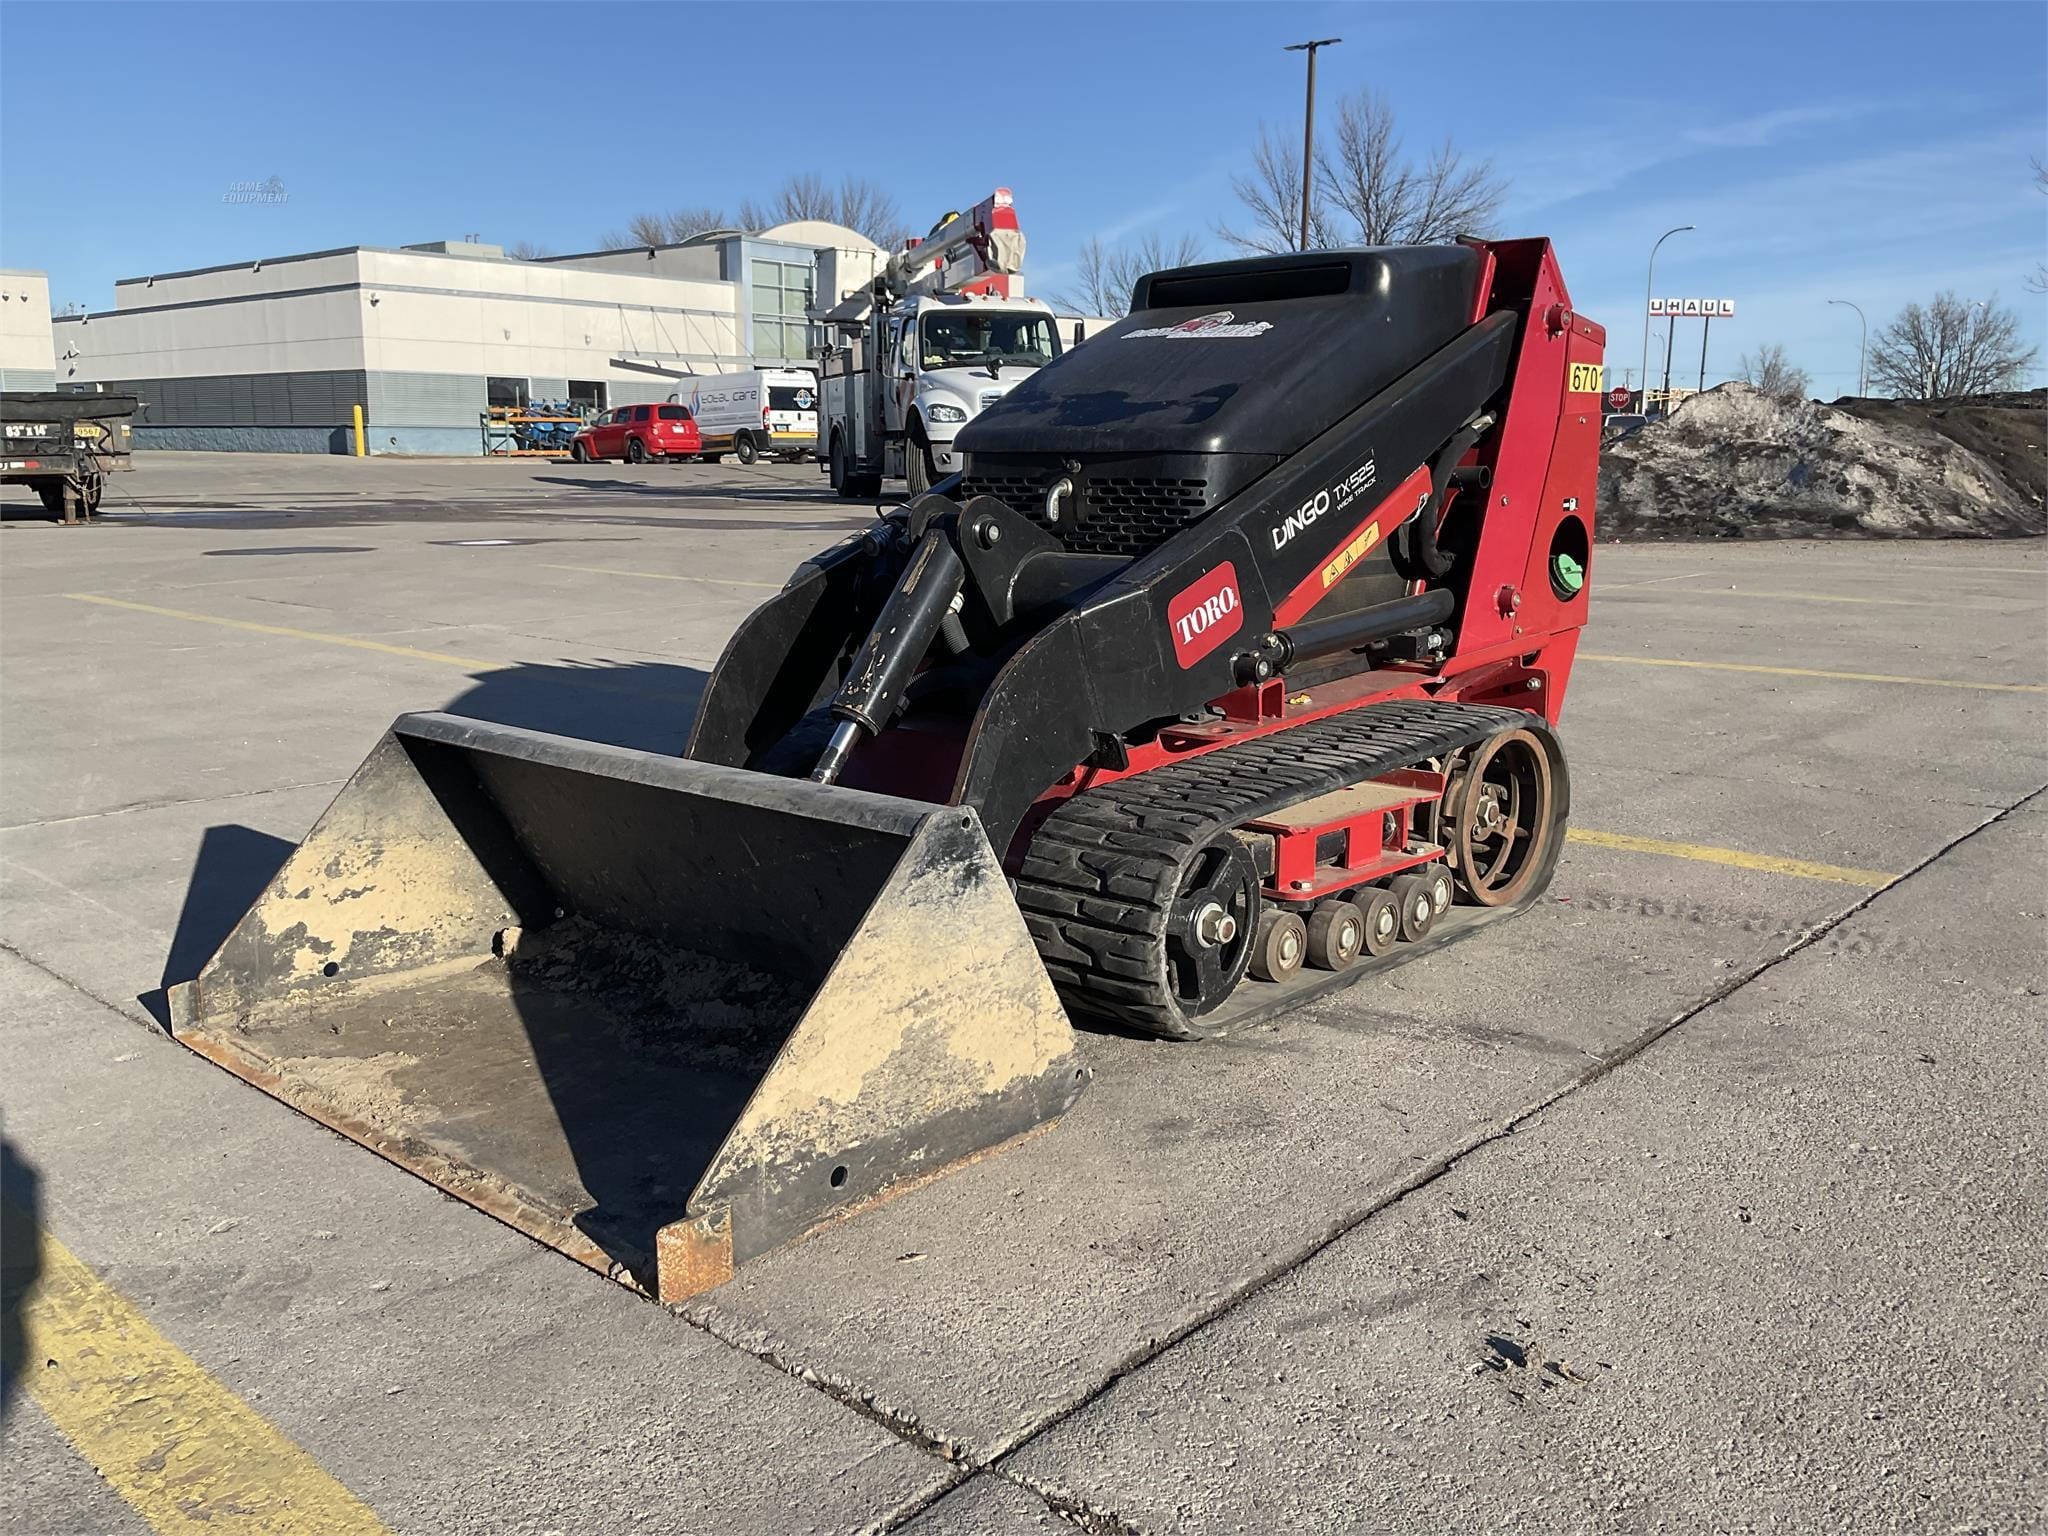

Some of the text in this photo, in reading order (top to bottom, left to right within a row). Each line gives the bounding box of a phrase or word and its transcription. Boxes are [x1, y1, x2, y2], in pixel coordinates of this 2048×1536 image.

[1572, 366, 1603, 391] 670
[732, 390, 757, 402] care
[1610, 393, 1629, 402] STOP
[1336, 476, 1377, 511] WIDE TRACK
[1271, 490, 1330, 550] DINGO
[1176, 586, 1235, 645] TORO
